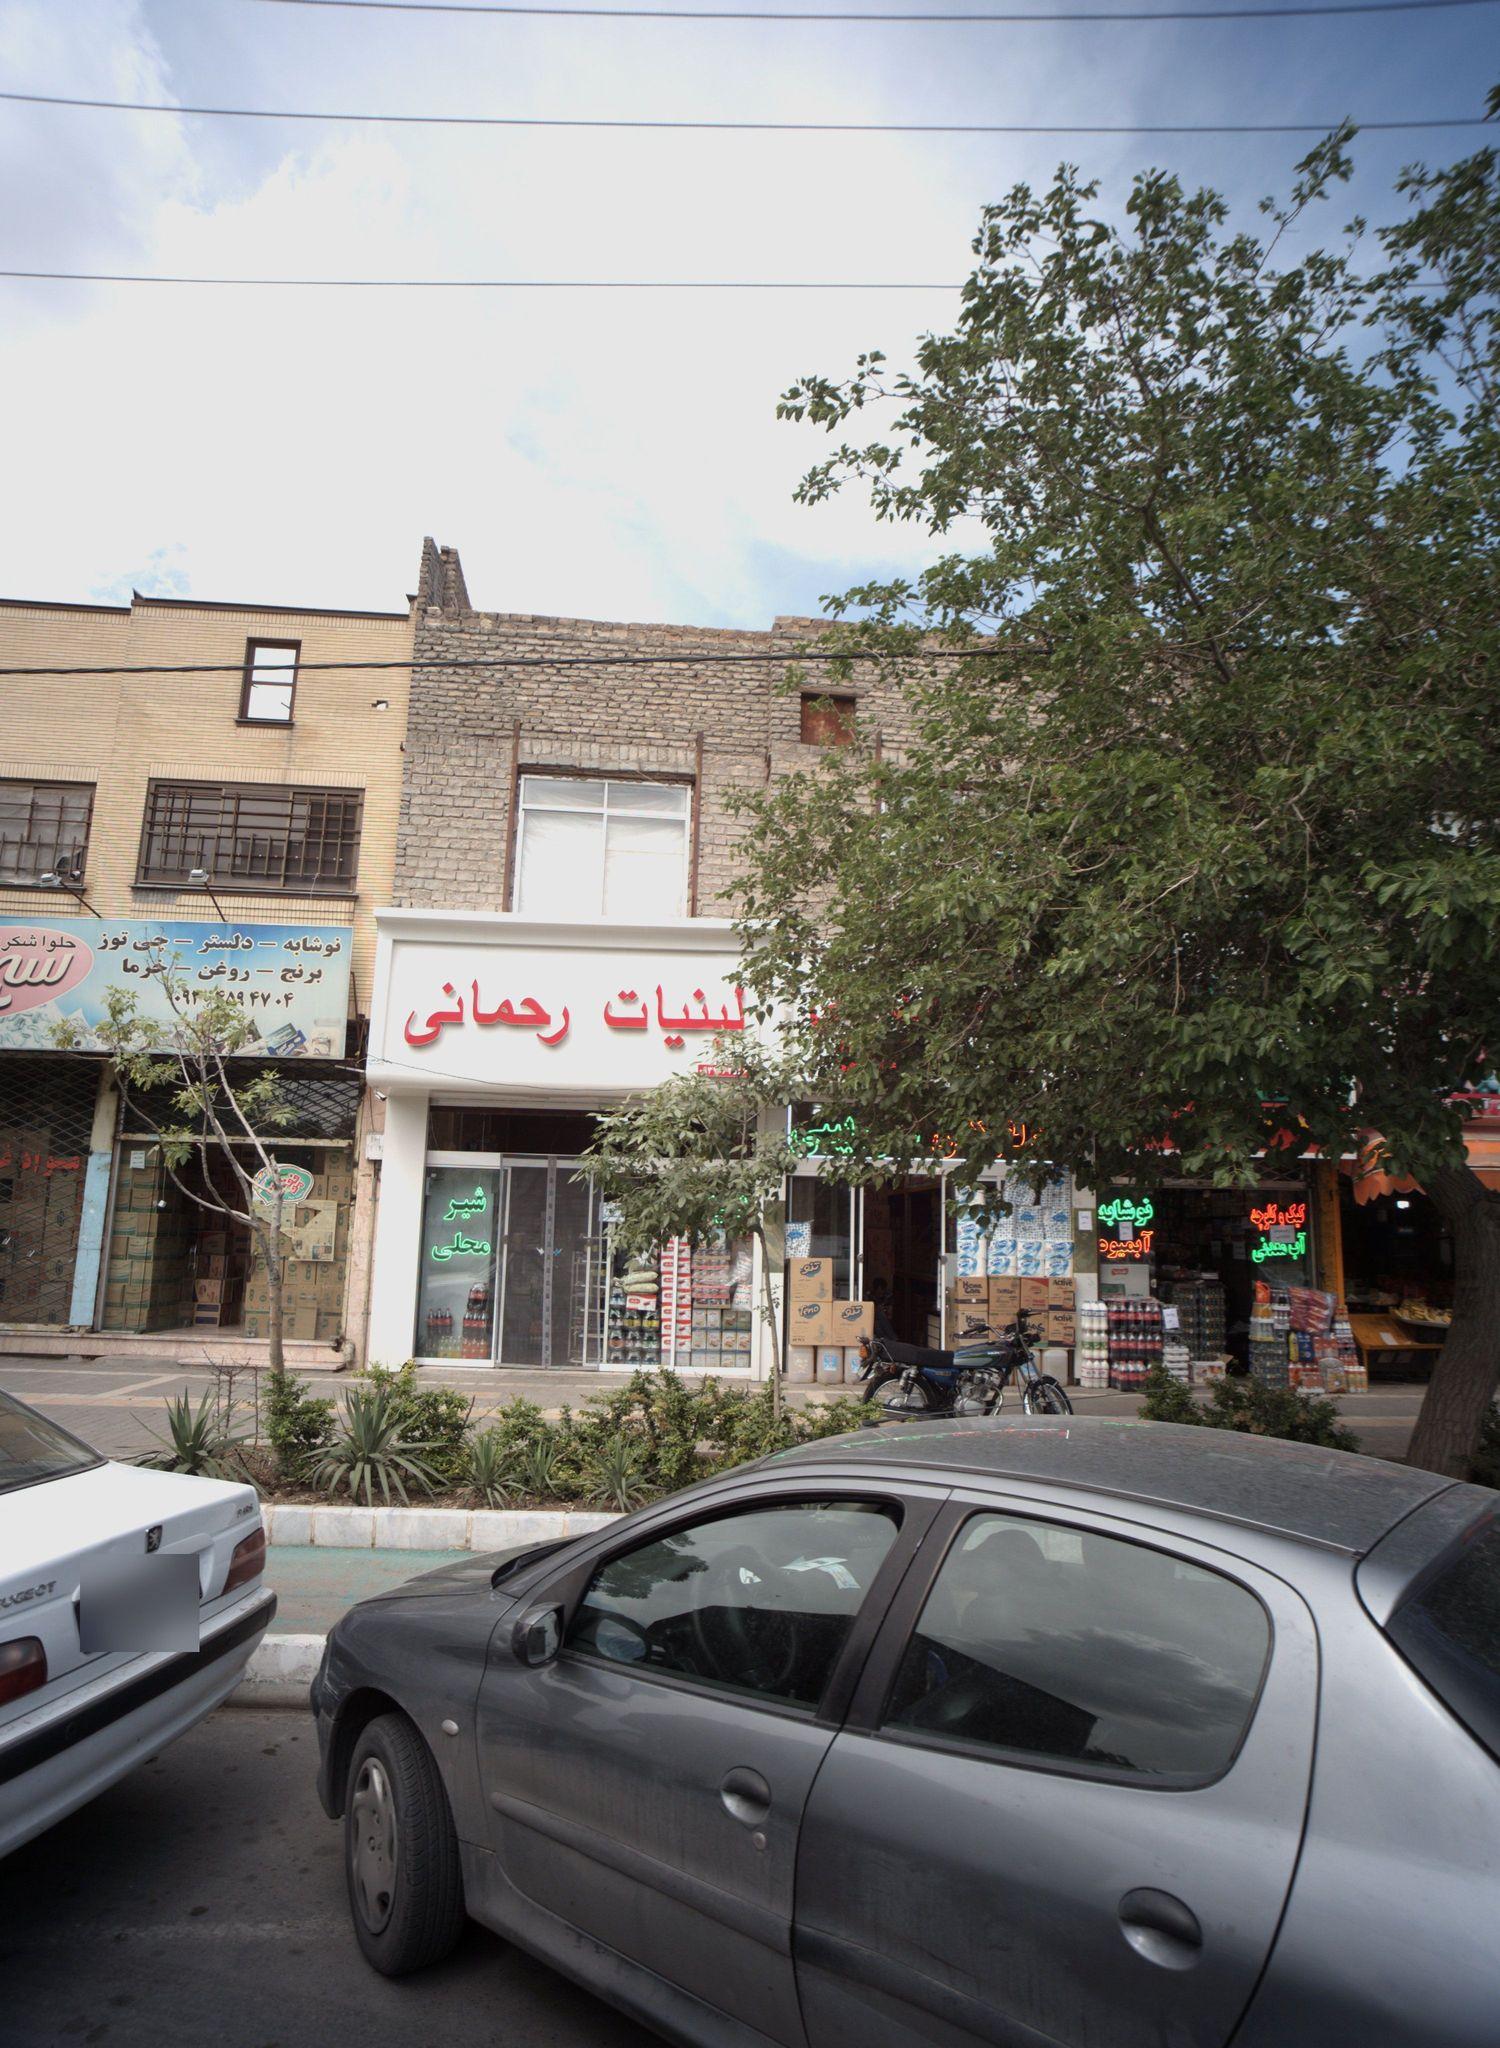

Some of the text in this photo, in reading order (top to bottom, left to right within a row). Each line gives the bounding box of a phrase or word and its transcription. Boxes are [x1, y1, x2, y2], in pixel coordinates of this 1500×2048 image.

[42, 935, 76, 952] حلوا
[97, 932, 342, 957] نوشابه دلستر چی توز
[122, 958, 322, 983] برنج روغن خرما
[404, 978, 570, 1047] رحمانی
[603, 983, 746, 1050] لبنیات
[443, 1186, 486, 1220] شیر
[1098, 1198, 1153, 1226] نوشابه
[1285, 1203, 1305, 1229] کیک
[432, 1231, 491, 1261] محلی
[1099, 1230, 1154, 1258] آبمیوه
[1288, 1232, 1307, 1260] آب
[0, 1580, 57, 1608] UGEOT
